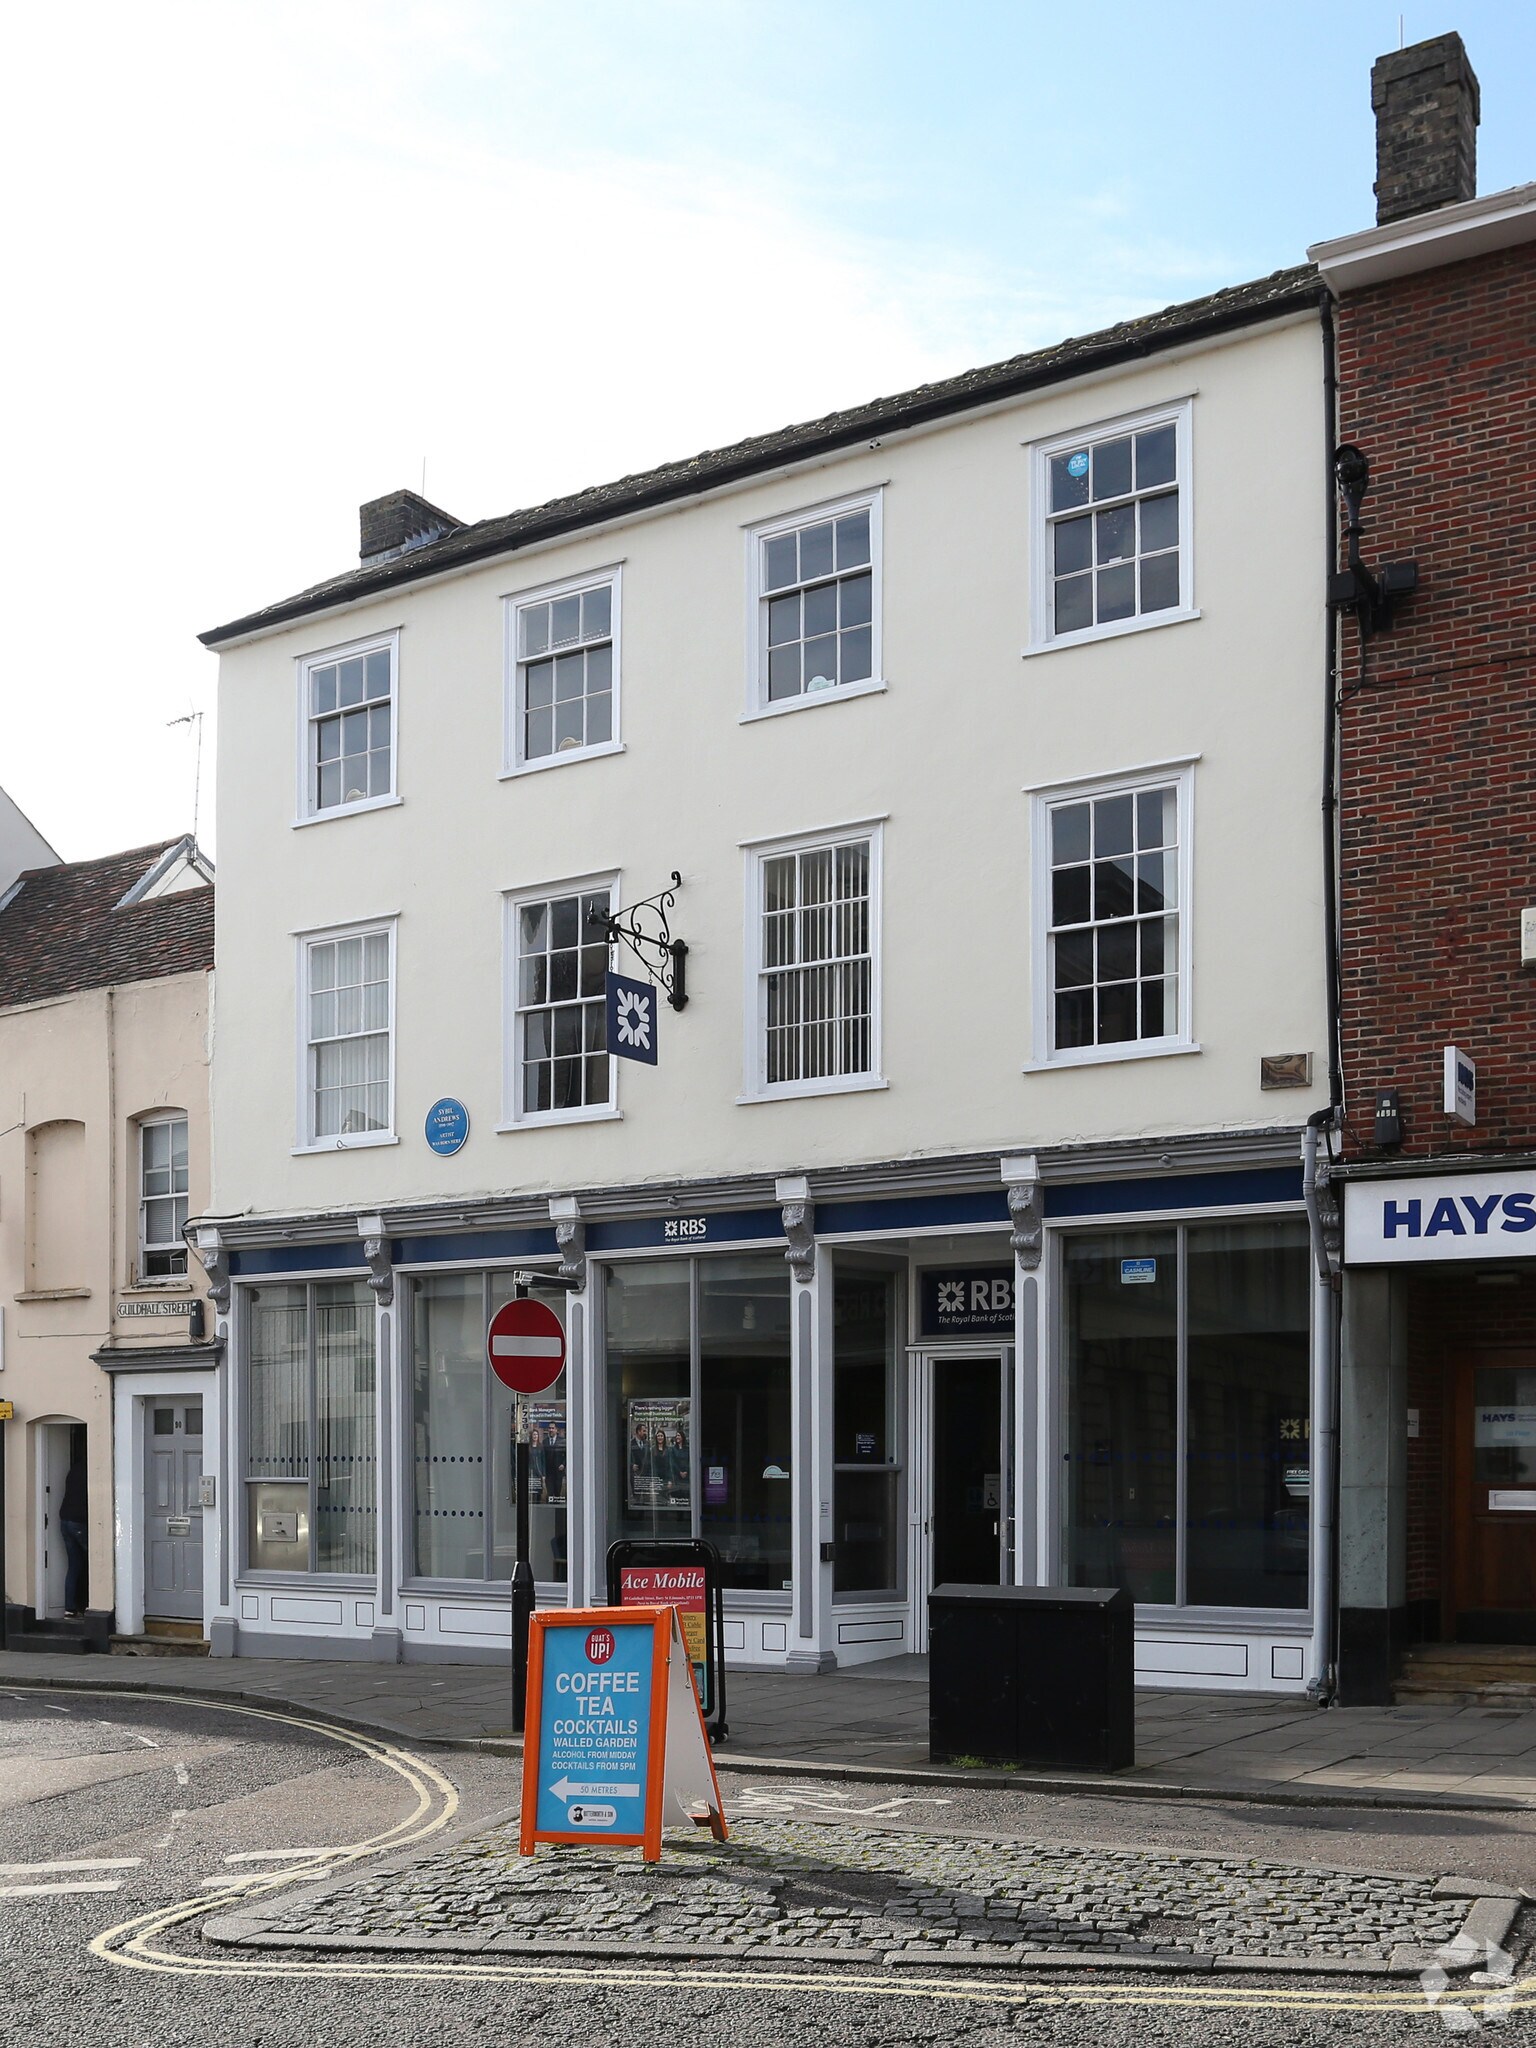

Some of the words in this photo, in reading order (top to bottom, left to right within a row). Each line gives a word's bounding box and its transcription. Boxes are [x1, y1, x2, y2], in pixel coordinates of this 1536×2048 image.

[1383, 1193, 1536, 1239] HAYS
[680, 1218, 707, 1236] RBS
[120, 1303, 161, 1316] GUILDHALL
[163, 1302, 191, 1314] STREET
[951, 1315, 970, 1325] Royal
[972, 1314, 988, 1322] Bank
[989, 1313, 998, 1323] of
[1482, 1413, 1516, 1423] HAYS
[621, 1574, 649, 1589] Ace
[653, 1572, 704, 1589] Mobile
[590, 1642, 610, 1659] UP!
[556, 1671, 640, 1694] COFFEE
[575, 1696, 615, 1716] TEA
[553, 1719, 638, 1735] COCKTAILS
[553, 1737, 593, 1748] WALLED
[595, 1738, 637, 1748] GARDEN
[552, 1750, 586, 1759] ALCOHOL
[587, 1751, 608, 1759] FROM
[609, 1751, 637, 1759] MIDDAY
[551, 1761, 595, 1770] COCKTAILS
[596, 1762, 618, 1770] FROM
[619, 1762, 636, 1771] 5PM
[580, 1786, 589, 1794] 50
[591, 1786, 618, 1794] METRES
